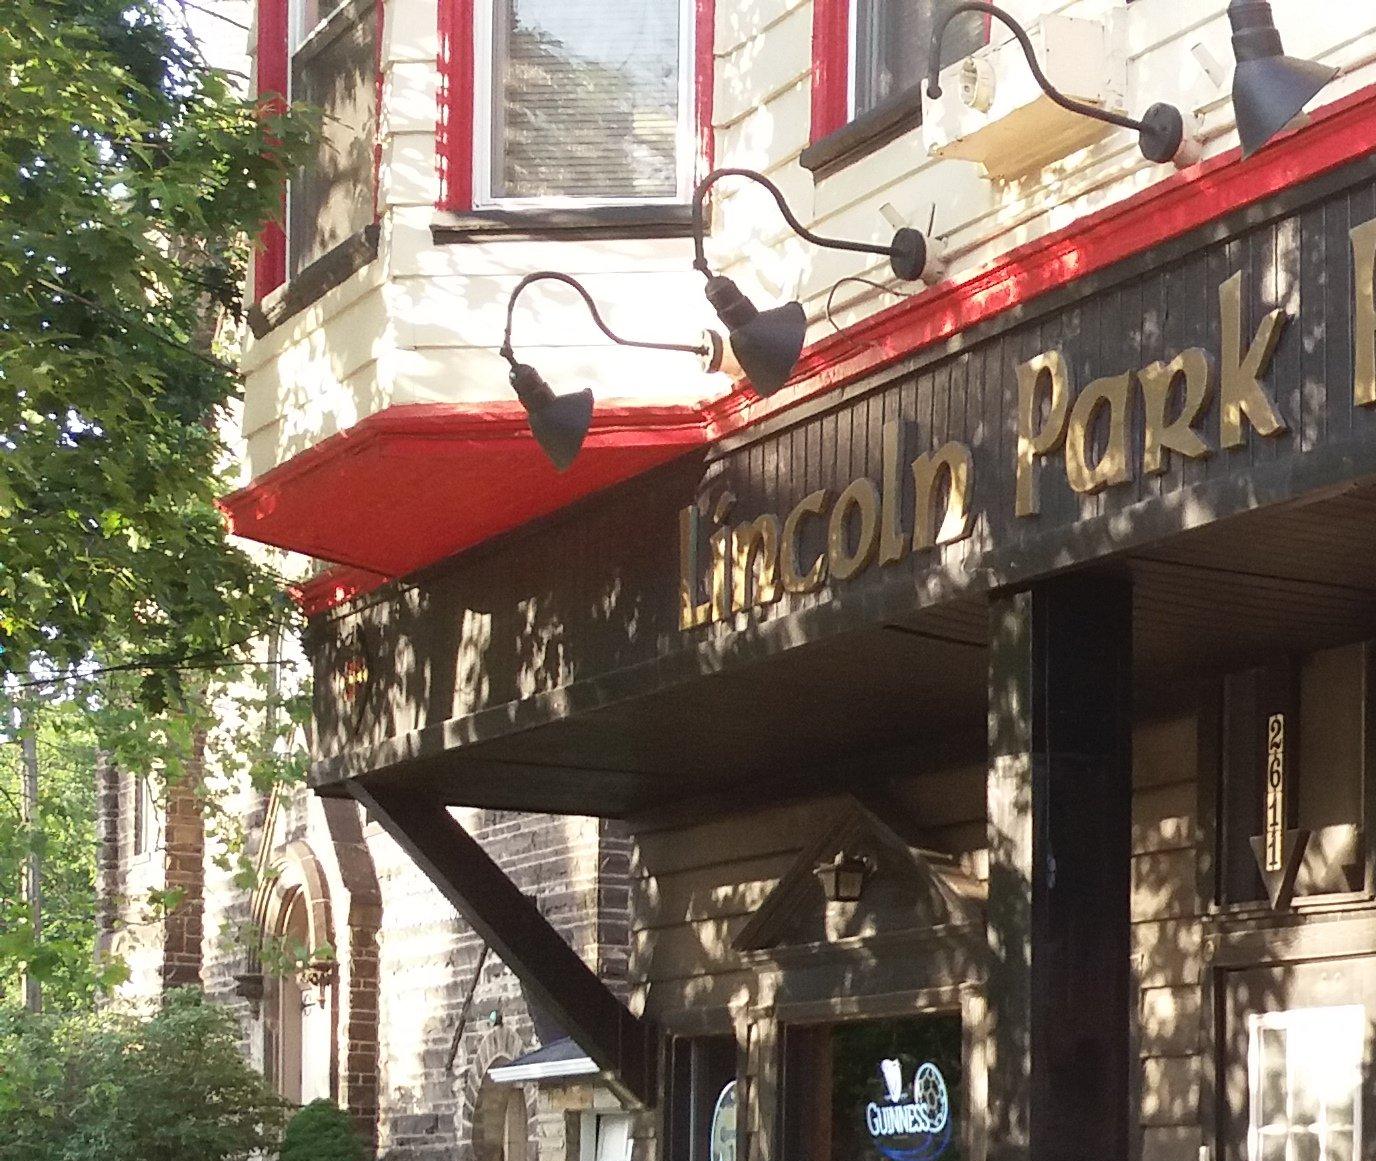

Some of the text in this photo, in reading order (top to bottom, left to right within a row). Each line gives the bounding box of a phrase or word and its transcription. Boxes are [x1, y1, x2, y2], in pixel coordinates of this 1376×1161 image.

[678, 417, 974, 631] Lincoln
[1014, 269, 1288, 517] Park
[1267, 715, 1283, 870] 2611
